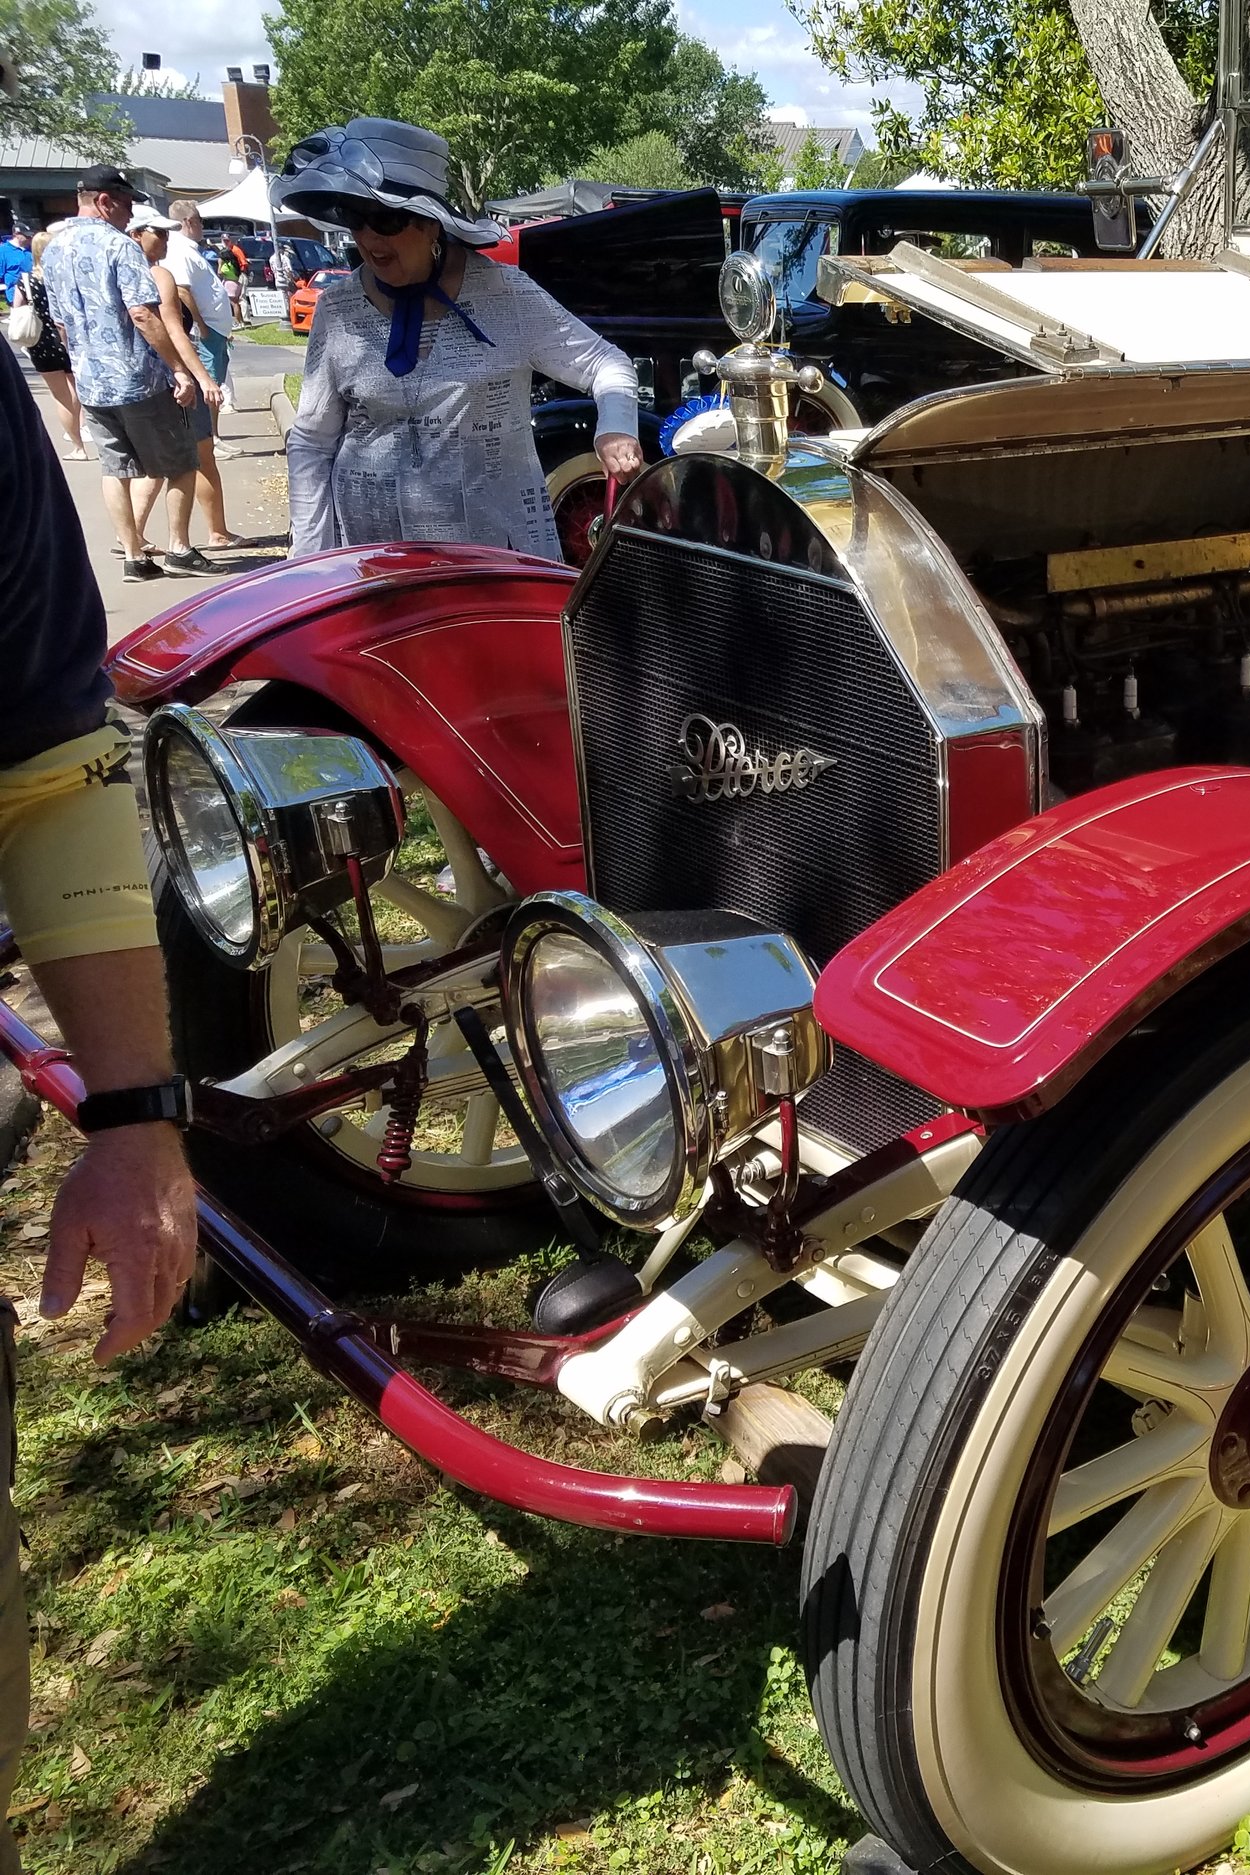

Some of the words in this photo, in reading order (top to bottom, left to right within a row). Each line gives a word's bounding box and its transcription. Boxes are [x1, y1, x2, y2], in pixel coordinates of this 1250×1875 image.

[424, 415, 442, 427] York
[472, 422, 487, 432] New
[679, 713, 810, 803] Pierce
[62, 883, 149, 900] OMNI-SHADE
